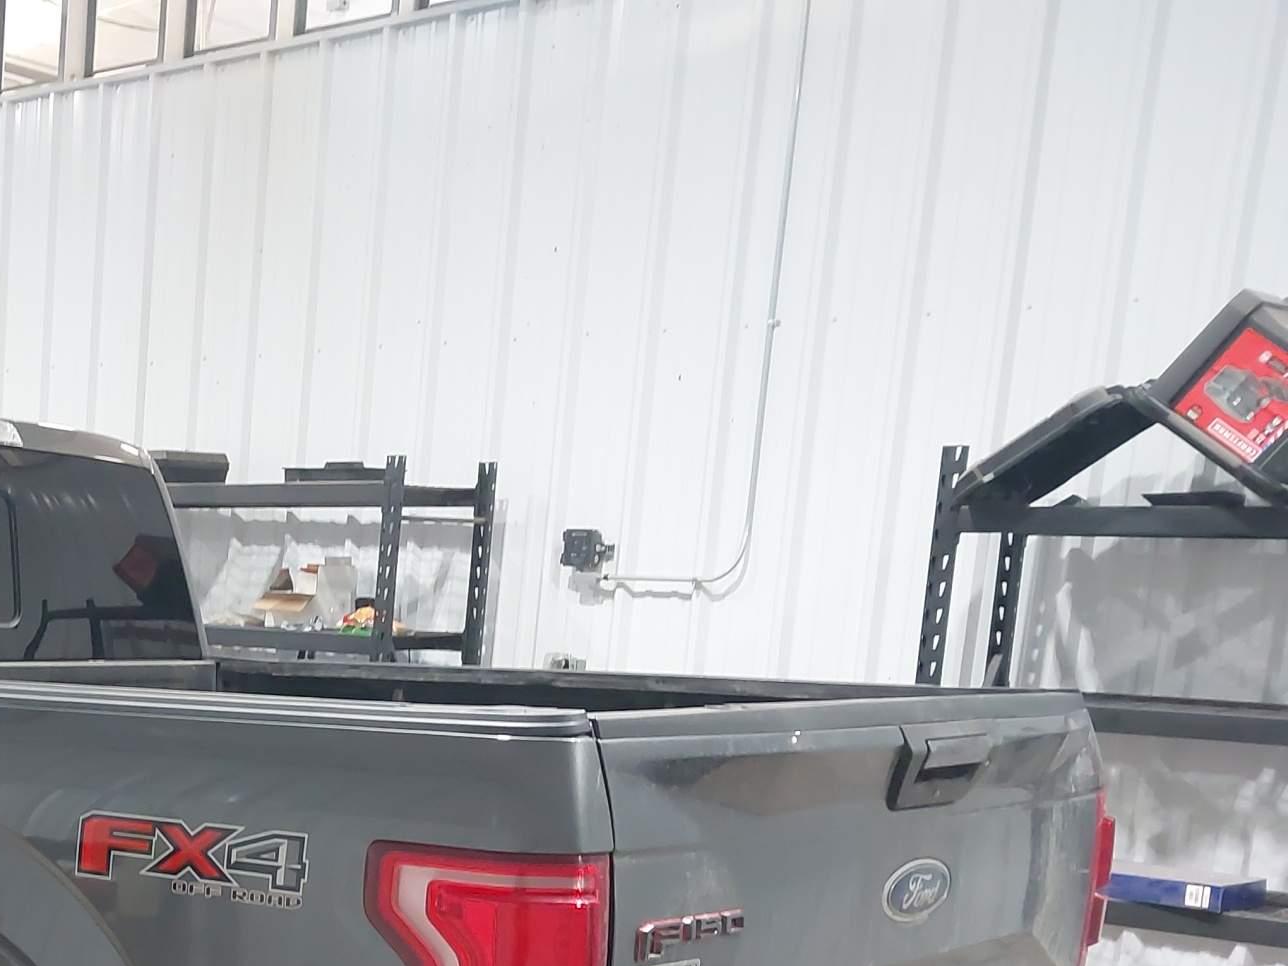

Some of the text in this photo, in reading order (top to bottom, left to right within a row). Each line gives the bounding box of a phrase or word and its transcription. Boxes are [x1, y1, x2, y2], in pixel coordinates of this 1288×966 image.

[75, 810, 309, 895] FX4
[172, 879, 302, 909] OFF ROAD
[901, 873, 941, 909] Ford
